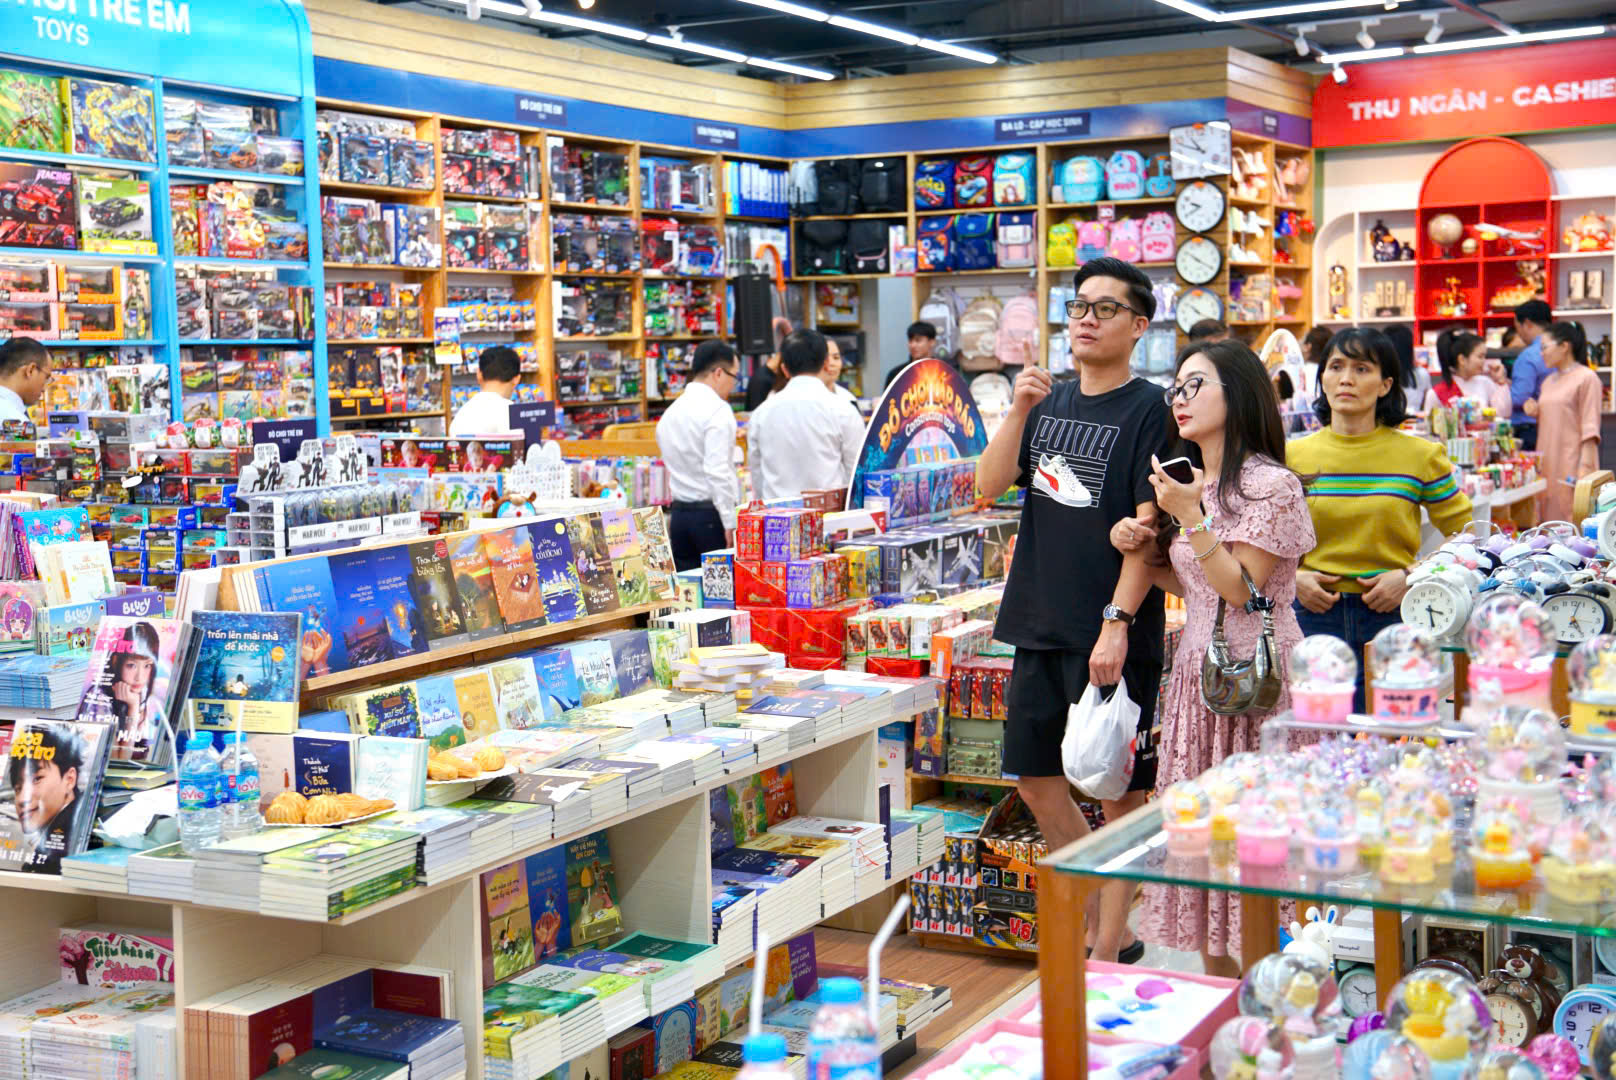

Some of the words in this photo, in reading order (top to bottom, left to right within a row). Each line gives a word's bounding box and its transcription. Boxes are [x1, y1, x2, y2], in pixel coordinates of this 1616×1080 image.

[148, 0, 191, 35] EM
[33, 16, 89, 46] TOYS
[1348, 98, 1400, 121] THU
[1409, 88, 1487, 116] NGÂN
[879, 398, 900, 454] ĐỒ
[901, 381, 933, 418] CHƠI
[954, 393, 975, 438] RÁP
[1030, 415, 1120, 461] PUMA
[348, 524, 359, 532] WAR
[360, 522, 370, 531] WOLF
[402, 517, 412, 525] WOLF
[302, 530, 314, 539] WAR
[314, 528, 326, 537] WOLF
[122, 597, 151, 617] BLUEY
[64, 606, 93, 624] BLUEY
[207, 628, 226, 639] trốn
[228, 630, 241, 640] lên
[243, 630, 260, 640] mái
[262, 631, 279, 641] nhà
[224, 640, 237, 651] để
[238, 642, 260, 652] khóc
[312, 775, 329, 785] Bữa
[303, 786, 321, 795] Cơm
[36, 853, 48, 865] Z?
[1009, 917, 1033, 941] V6
[1588, 1003, 1602, 1014] 12
[1566, 1020, 1577, 1032] 9
